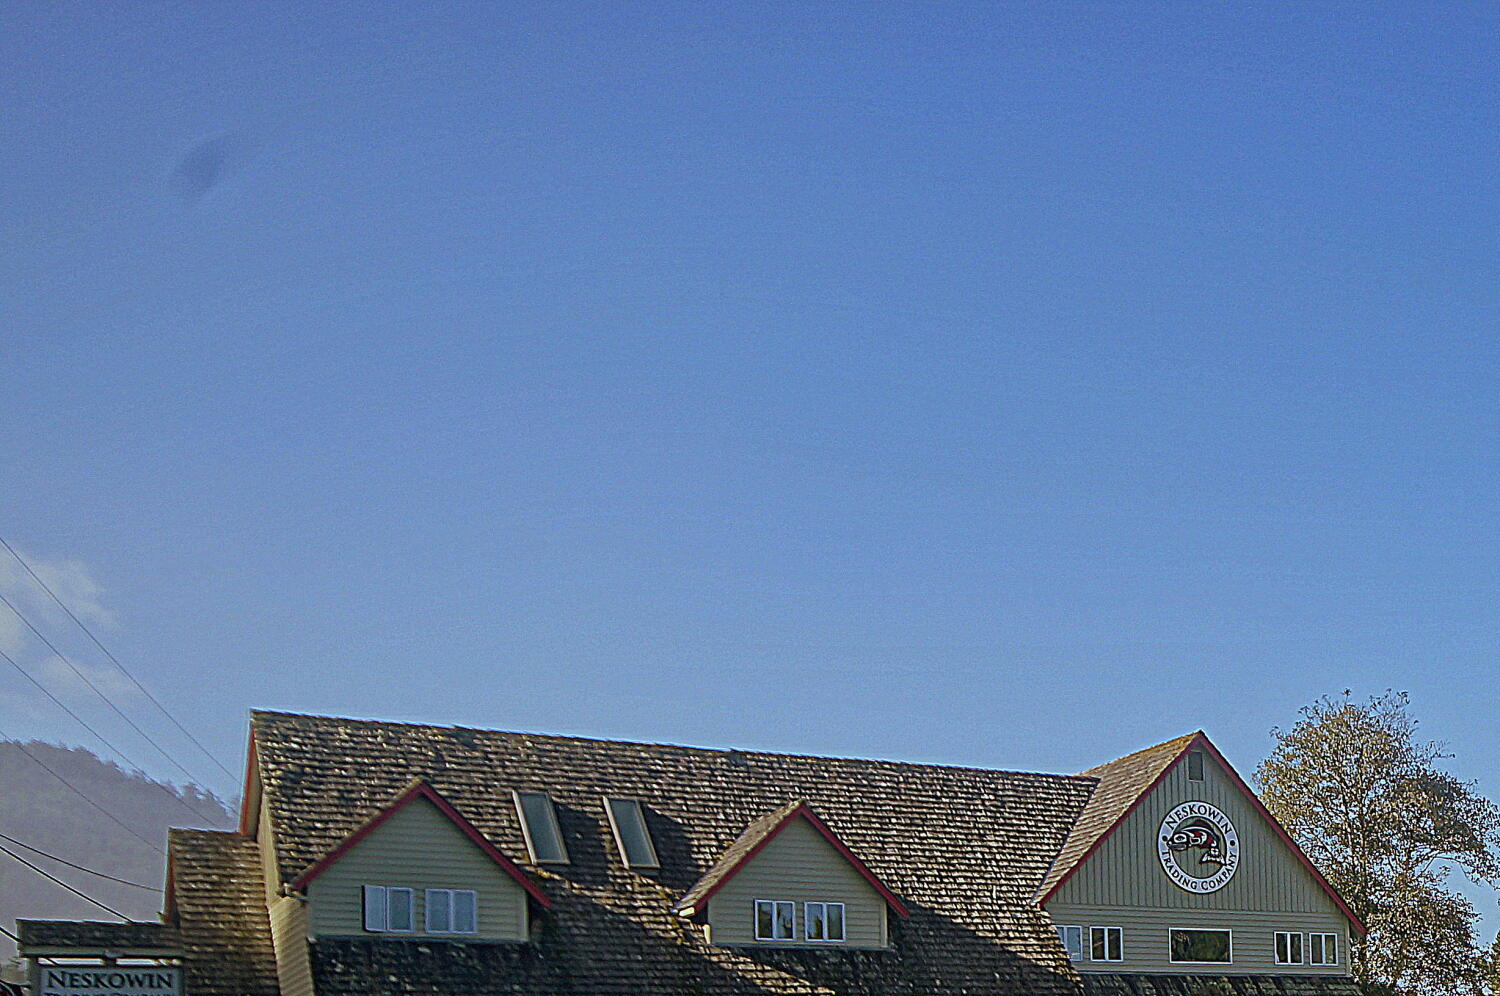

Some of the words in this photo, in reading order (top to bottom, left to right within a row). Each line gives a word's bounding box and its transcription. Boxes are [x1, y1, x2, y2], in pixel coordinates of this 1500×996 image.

[1165, 804, 1233, 835] NESKOWIN
[1162, 849, 1198, 890] TRADING
[1200, 851, 1237, 890] COMPANY
[47, 970, 172, 989] NESKOWIN
